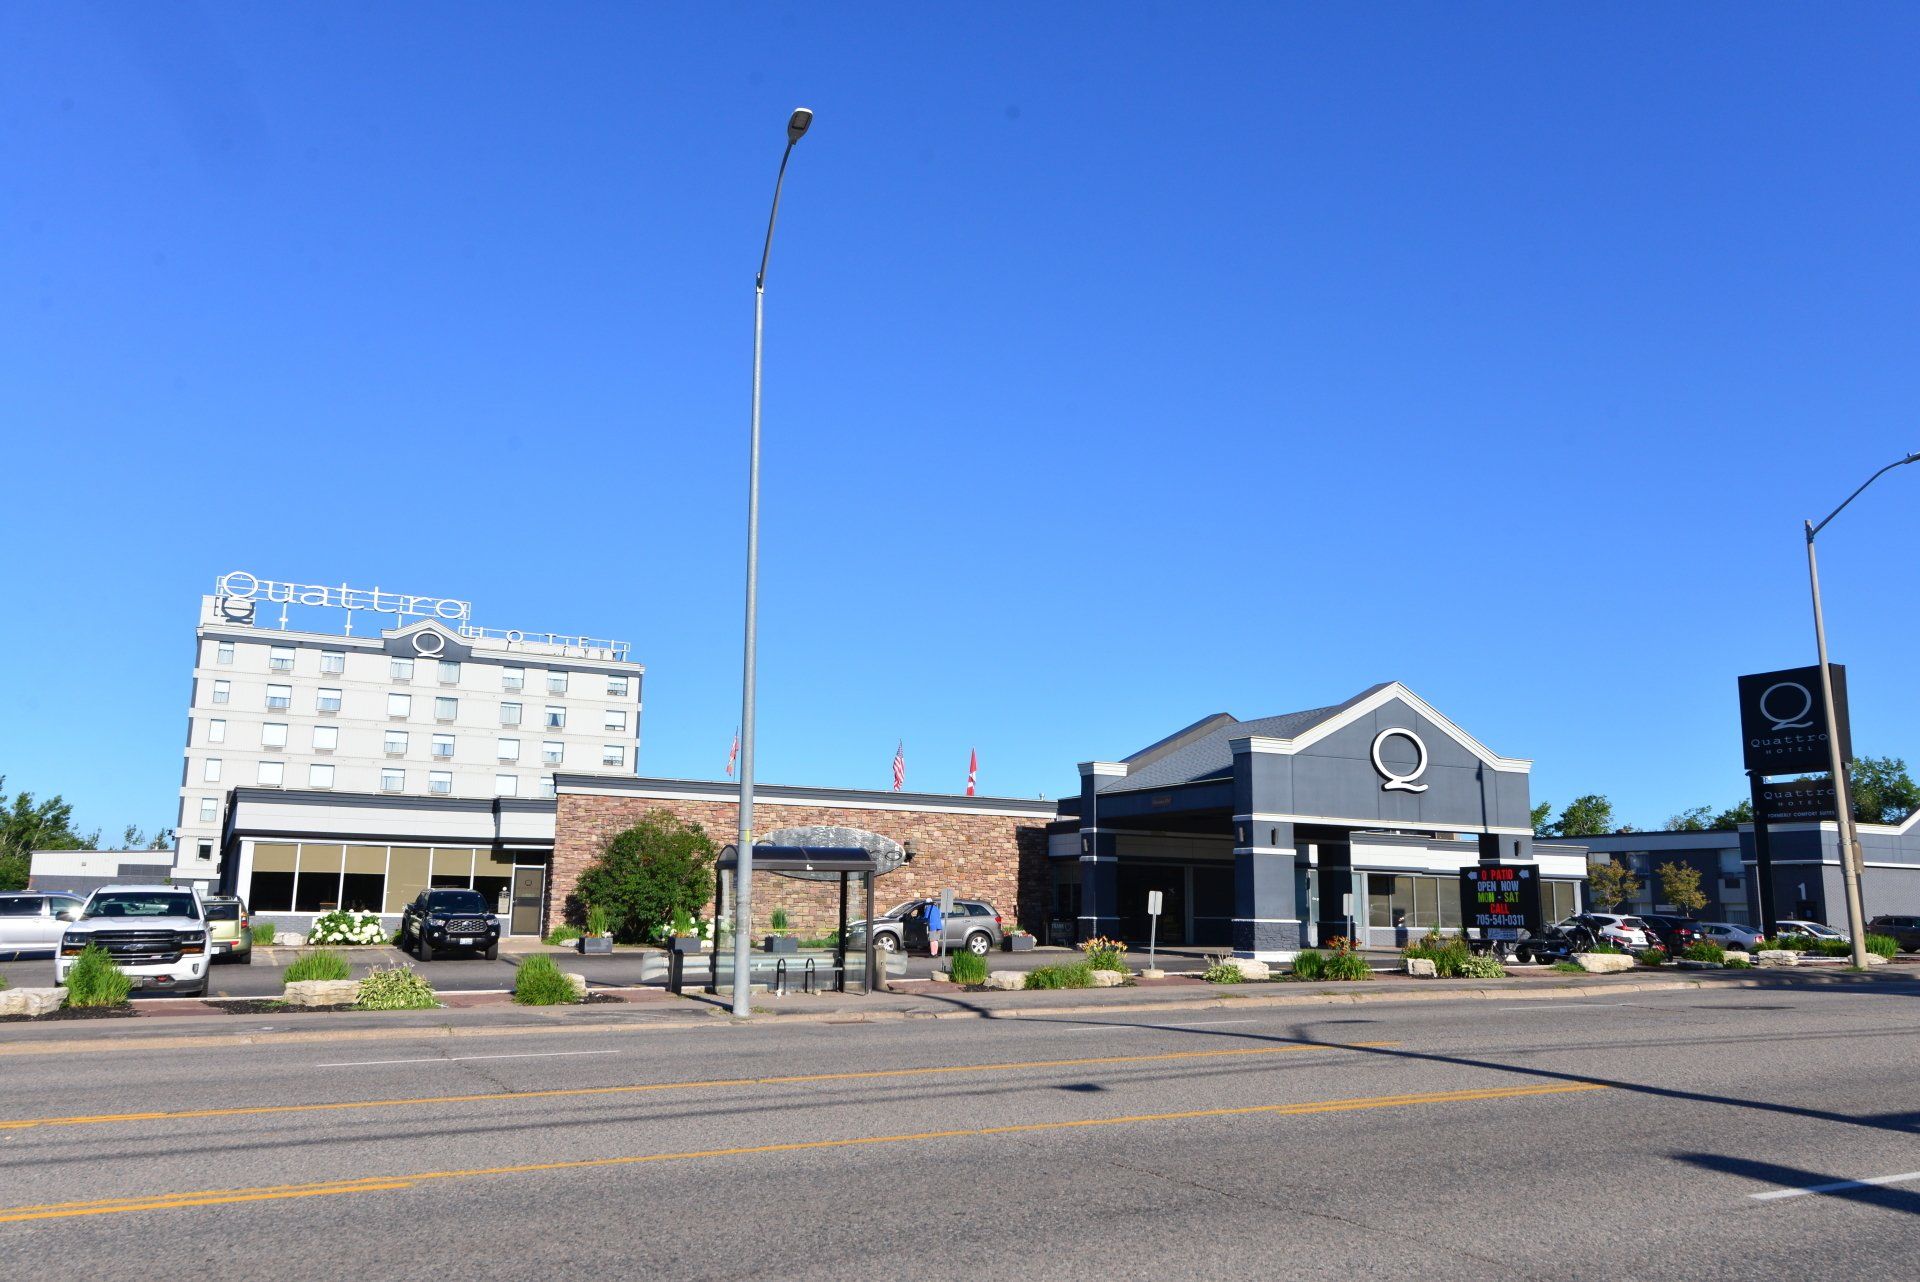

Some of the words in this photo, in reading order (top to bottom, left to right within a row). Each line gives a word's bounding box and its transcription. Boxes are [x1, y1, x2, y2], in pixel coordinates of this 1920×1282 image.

[222, 571, 466, 619] Quattro
[469, 625, 619, 652] HOTEL
[1759, 682, 1814, 731] Q
[1750, 733, 1828, 748] Quattro
[1765, 745, 1813, 754] HOTEL
[1372, 727, 1429, 792] Q
[1778, 799, 1822, 807] HOTEL
[1491, 869, 1513, 880] PATIO
[1477, 881, 1496, 891] OPEN
[1501, 880, 1518, 891] NOW
[1798, 882, 1807, 900] 1
[1477, 892, 1495, 903] MON
[1504, 892, 1520, 903] SAT
[1490, 904, 1508, 913] CALL
[1476, 915, 1524, 926] 705-541-0311
